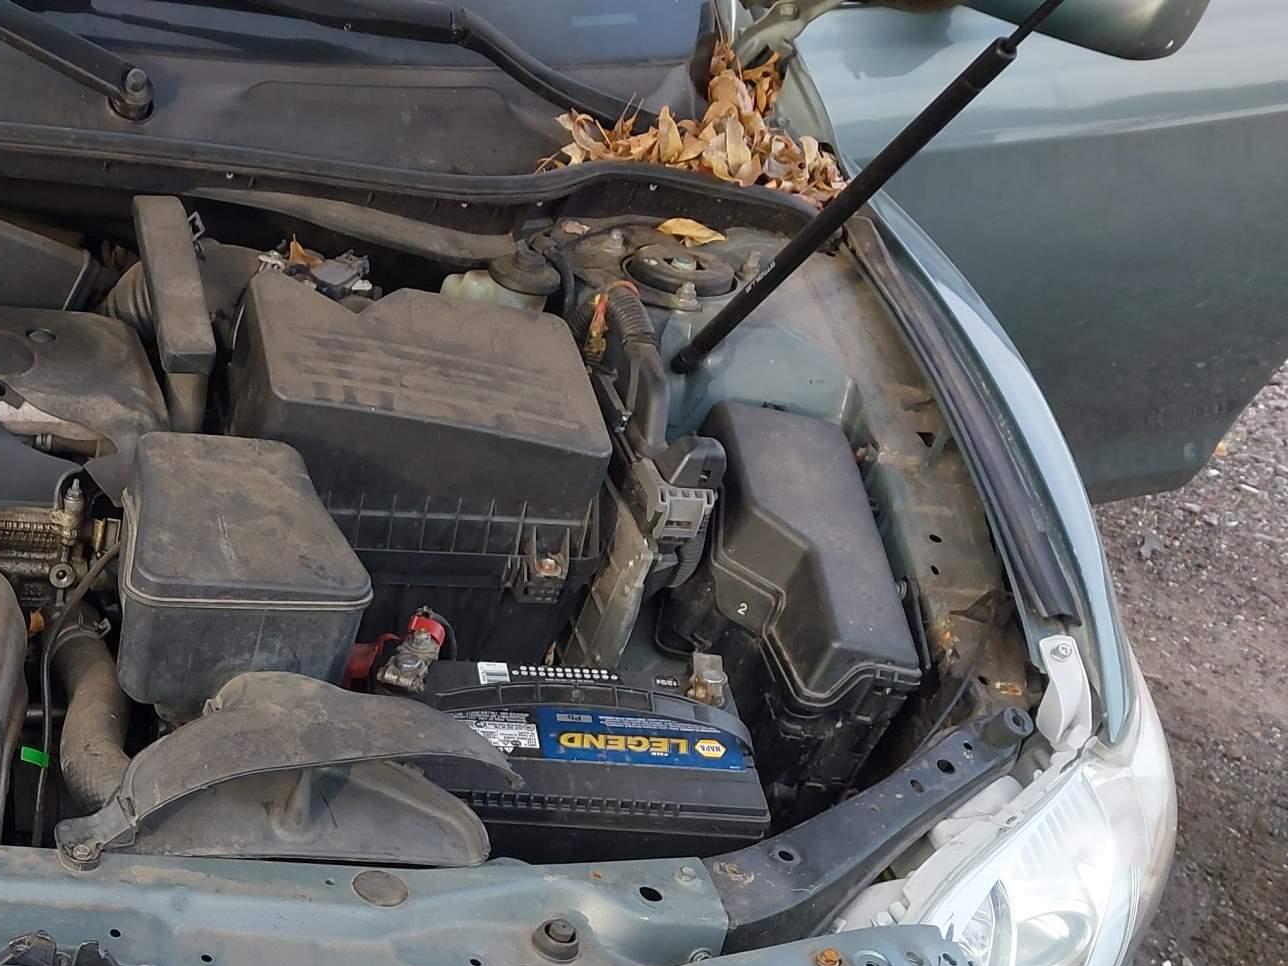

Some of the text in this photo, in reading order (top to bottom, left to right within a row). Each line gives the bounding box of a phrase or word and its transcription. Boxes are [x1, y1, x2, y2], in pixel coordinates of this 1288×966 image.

[737, 602, 748, 615] 2
[559, 732, 689, 755] LEGEND
[700, 744, 721, 752] NAPA
